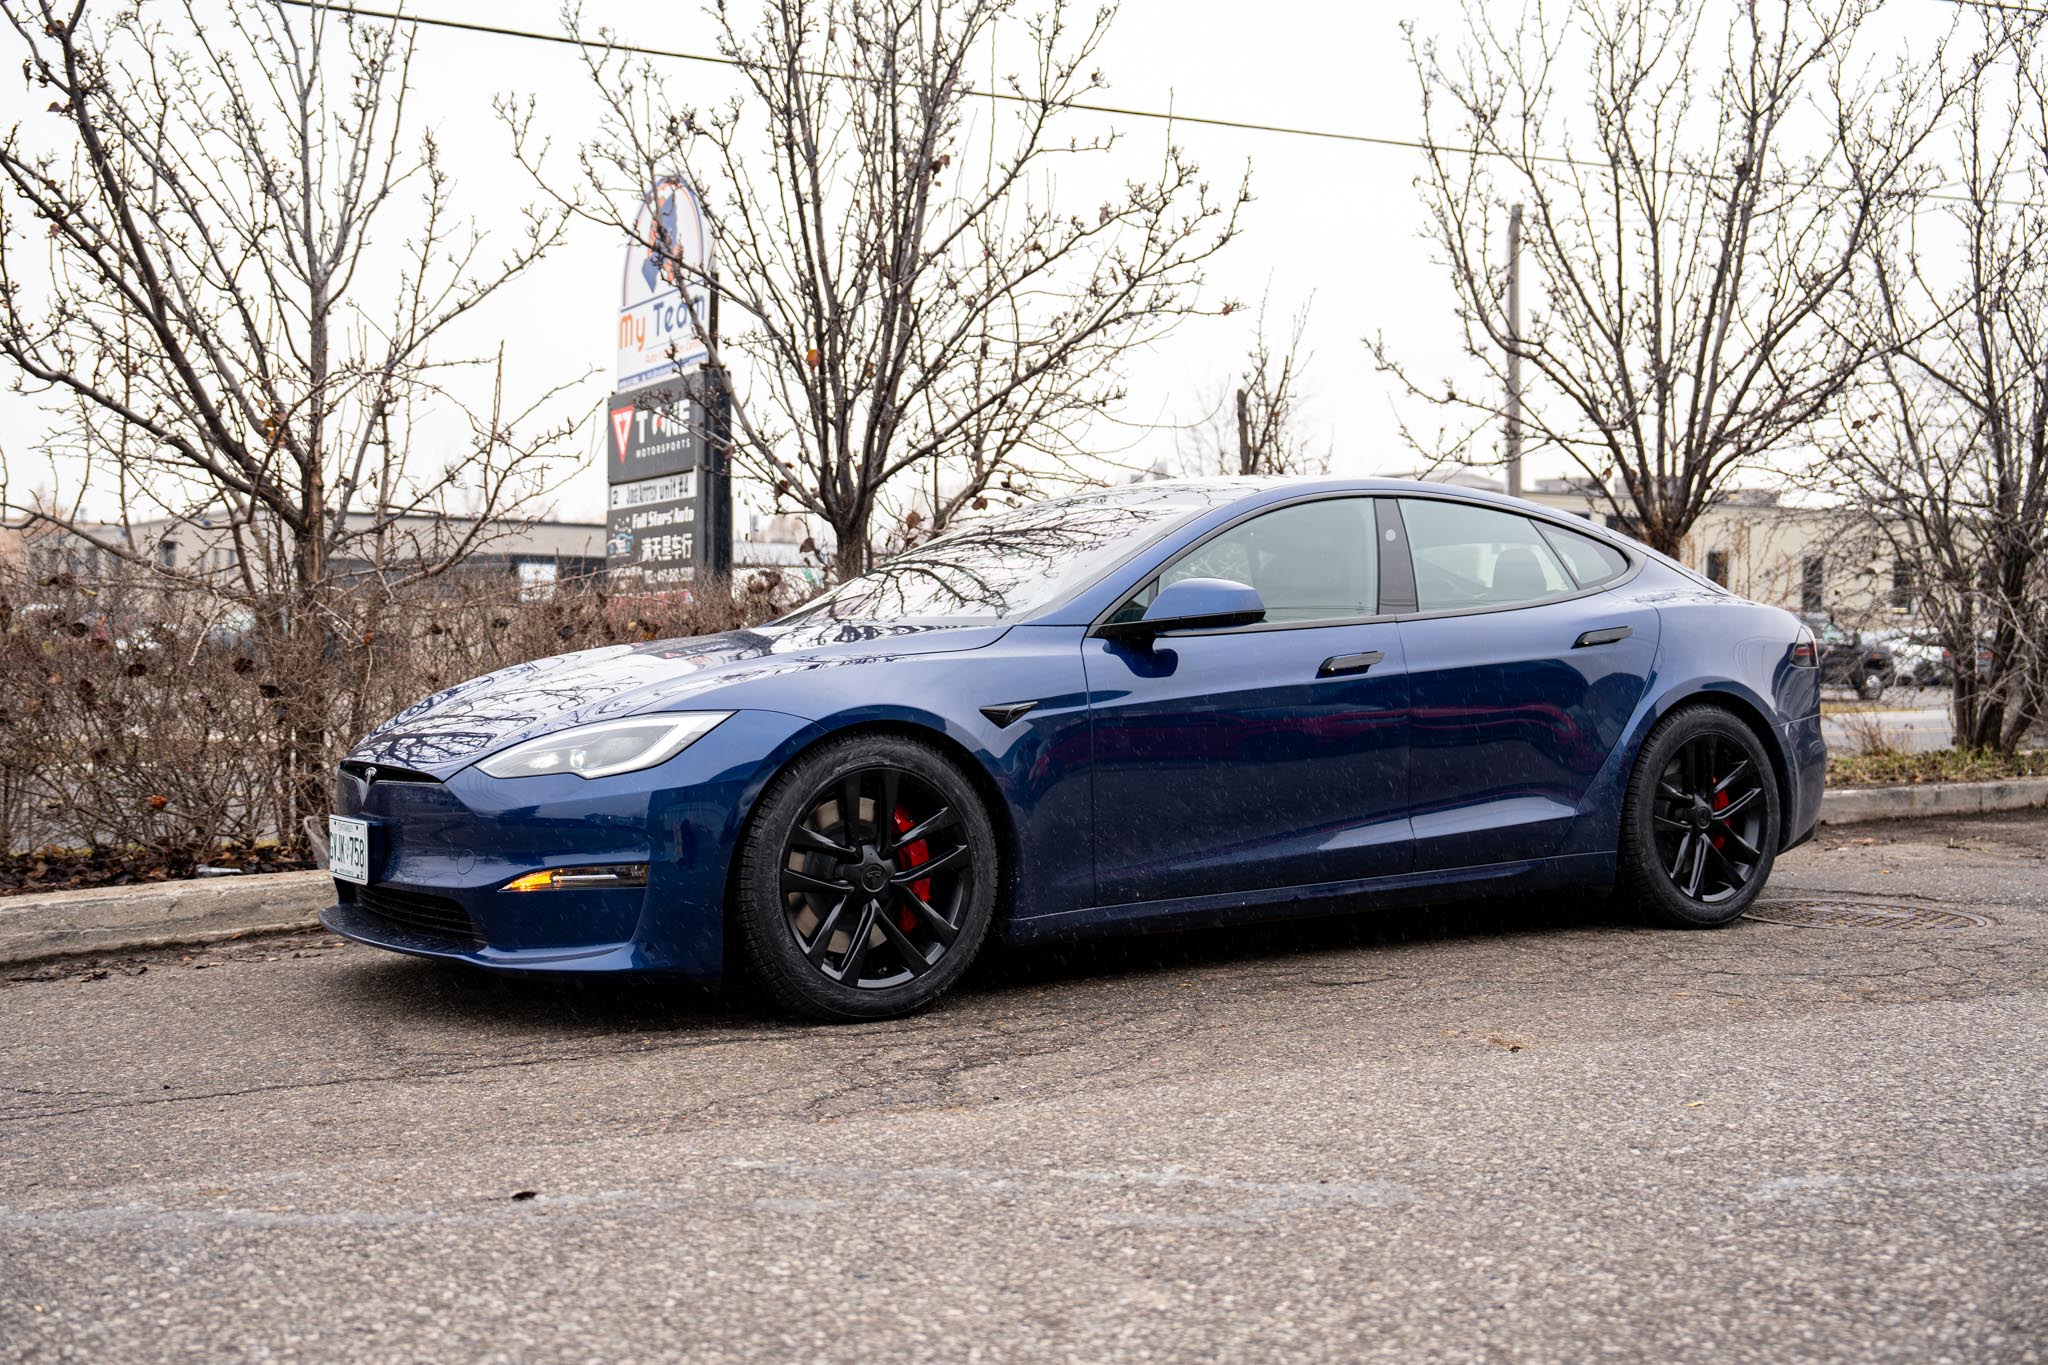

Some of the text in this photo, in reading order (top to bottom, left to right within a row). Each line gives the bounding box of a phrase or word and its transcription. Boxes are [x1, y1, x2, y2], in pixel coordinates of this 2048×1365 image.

[635, 438, 691, 459] MOTORSPORTS
[613, 489, 619, 505] 2
[631, 512, 648, 530] Full
[673, 506, 695, 524] Auto
